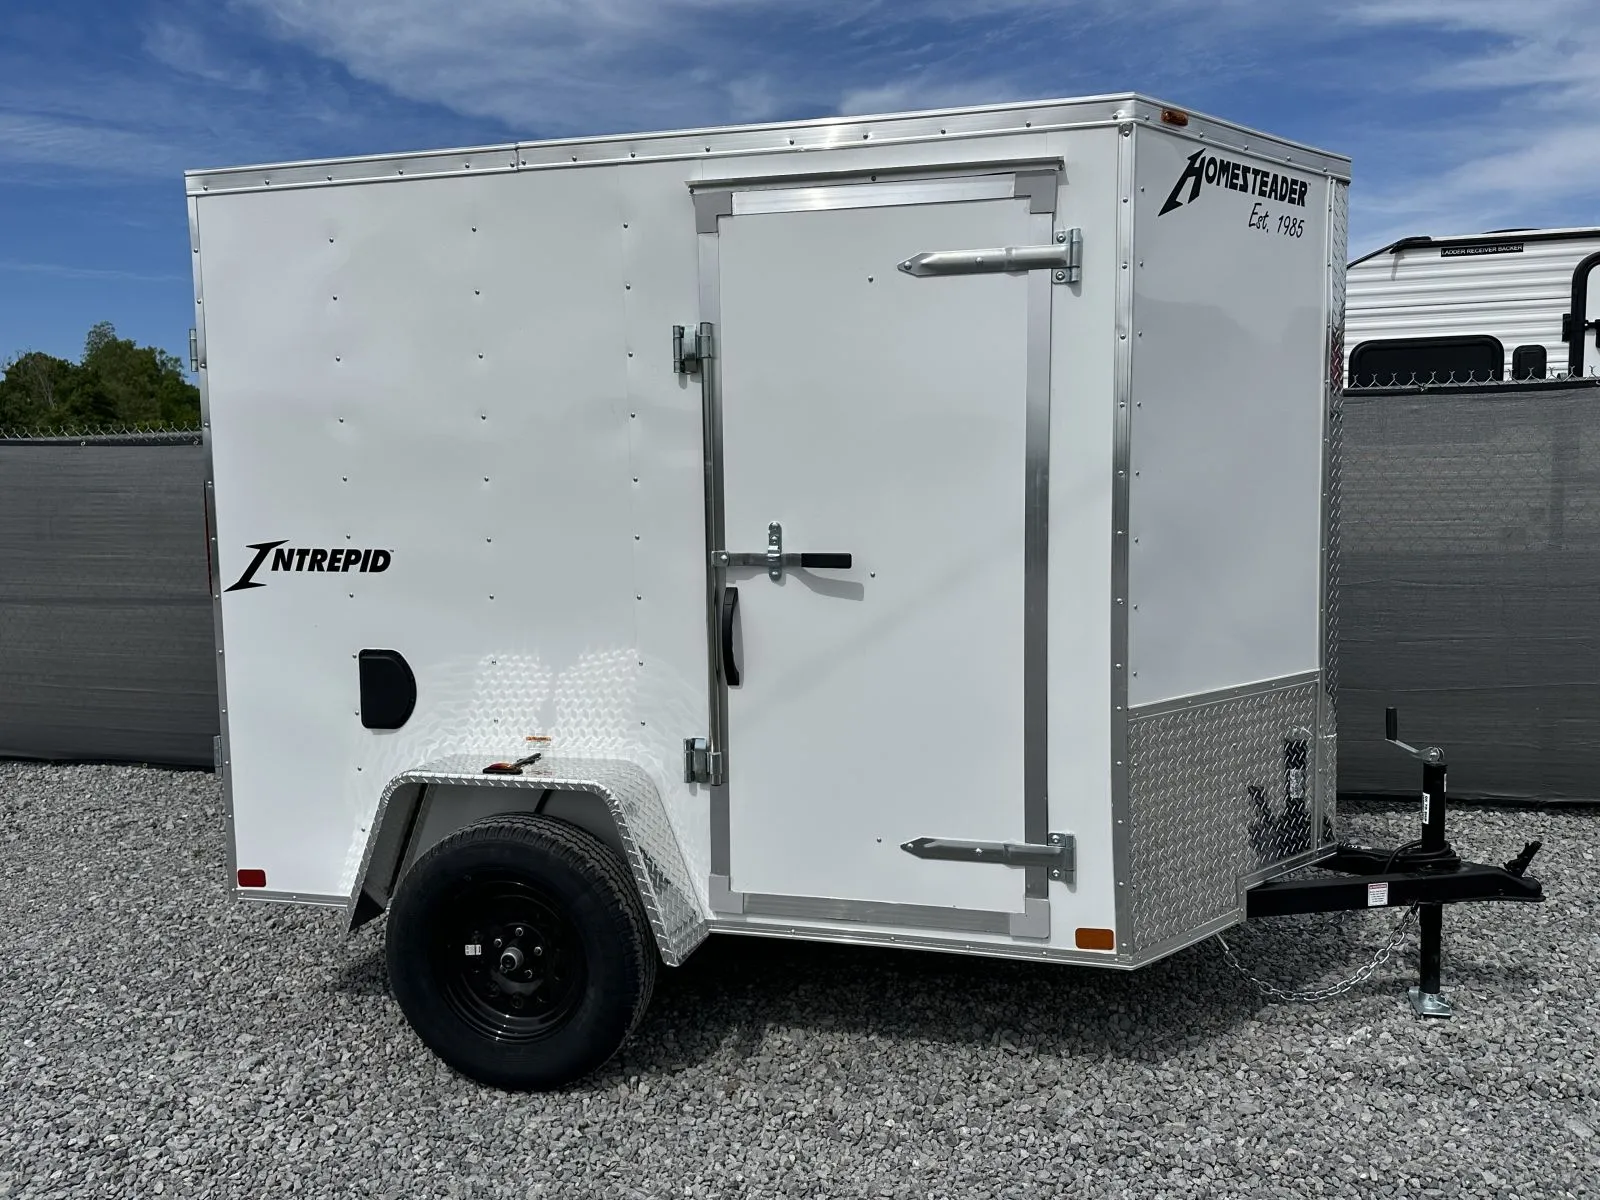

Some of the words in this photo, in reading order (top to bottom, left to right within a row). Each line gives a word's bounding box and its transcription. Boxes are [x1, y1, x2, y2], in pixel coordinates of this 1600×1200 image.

[1157, 147, 1308, 217] HOMESTEADER
[1248, 202, 1269, 233] Est.
[1277, 215, 1305, 239] 1985
[223, 539, 392, 593] INTREPID
